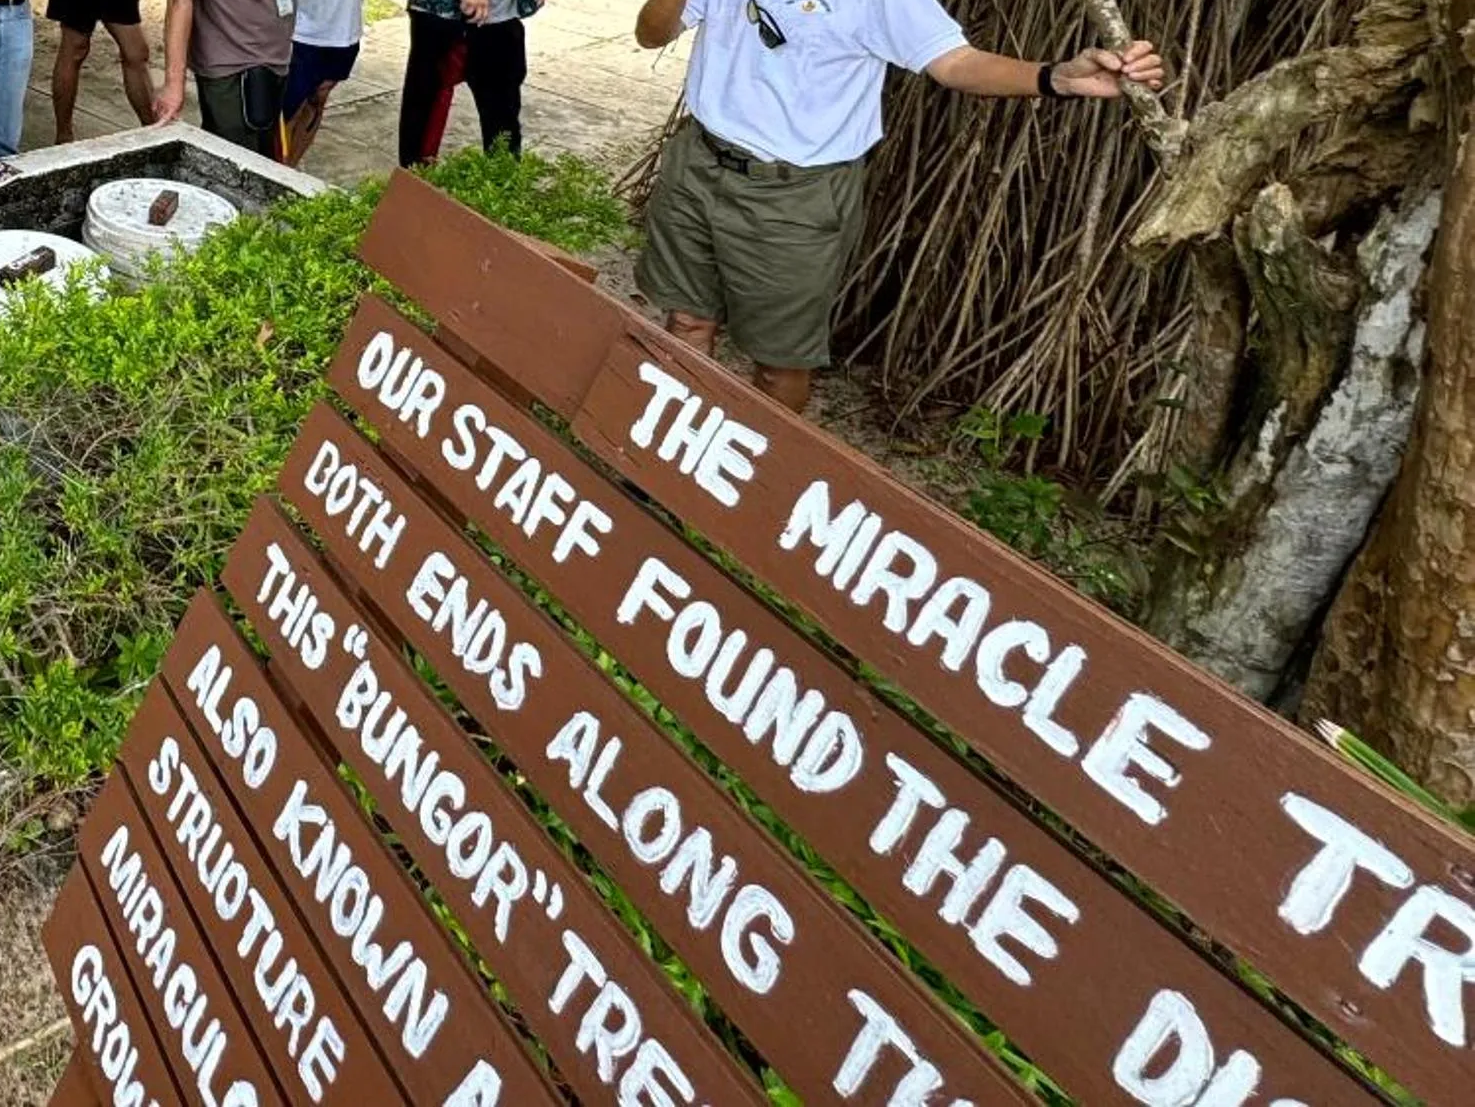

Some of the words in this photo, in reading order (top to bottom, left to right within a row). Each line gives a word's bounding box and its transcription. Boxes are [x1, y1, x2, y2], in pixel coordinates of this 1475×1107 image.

[186, 644, 278, 790] ALSO
[272, 779, 449, 1059] KNOWN
[255, 542, 336, 671] THIS
[335, 622, 565, 944] "BUNGOR"
[547, 929, 710, 1107] TRE
[303, 439, 407, 570] BOTH
[405, 551, 542, 711] ENDS
[545, 710, 795, 994] ALONG
[356, 331, 447, 439] OUR
[441, 404, 613, 563] STAFF
[616, 557, 864, 794] FOUND
[869, 751, 1080, 986] THE
[1112, 988, 1309, 1107] DI
[631, 361, 768, 508] THE
[778, 480, 1212, 826] MIRACLE
